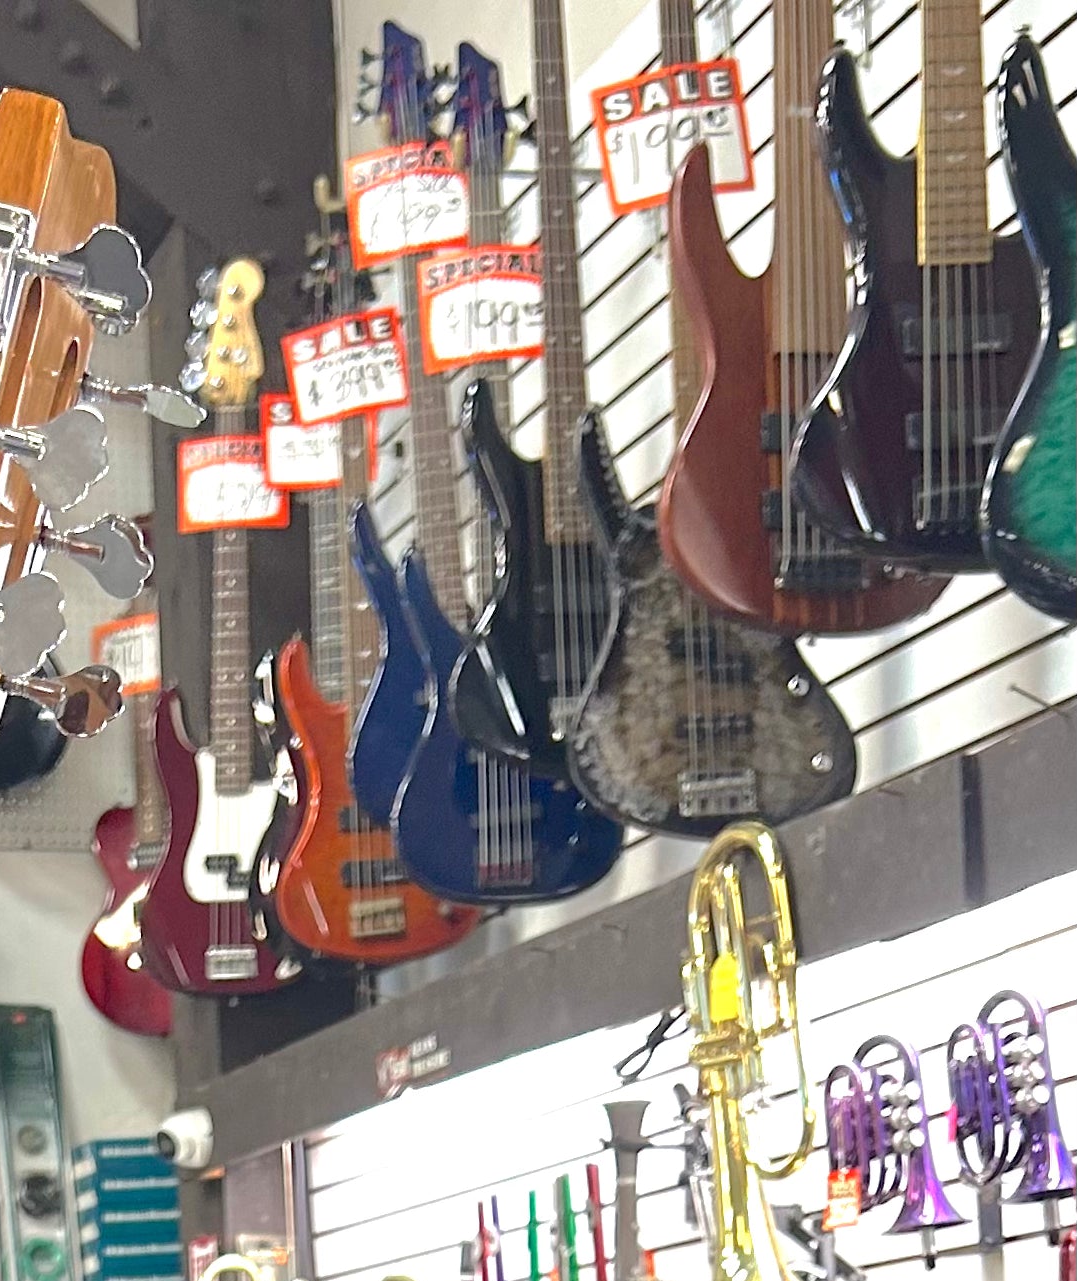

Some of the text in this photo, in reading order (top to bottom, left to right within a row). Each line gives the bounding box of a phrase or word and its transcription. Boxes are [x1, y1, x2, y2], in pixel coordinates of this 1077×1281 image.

[603, 68, 734, 122] SALE
[353, 148, 446, 188] SPECIA
[427, 252, 543, 289] SPECIAL
[291, 315, 394, 362] SALE
